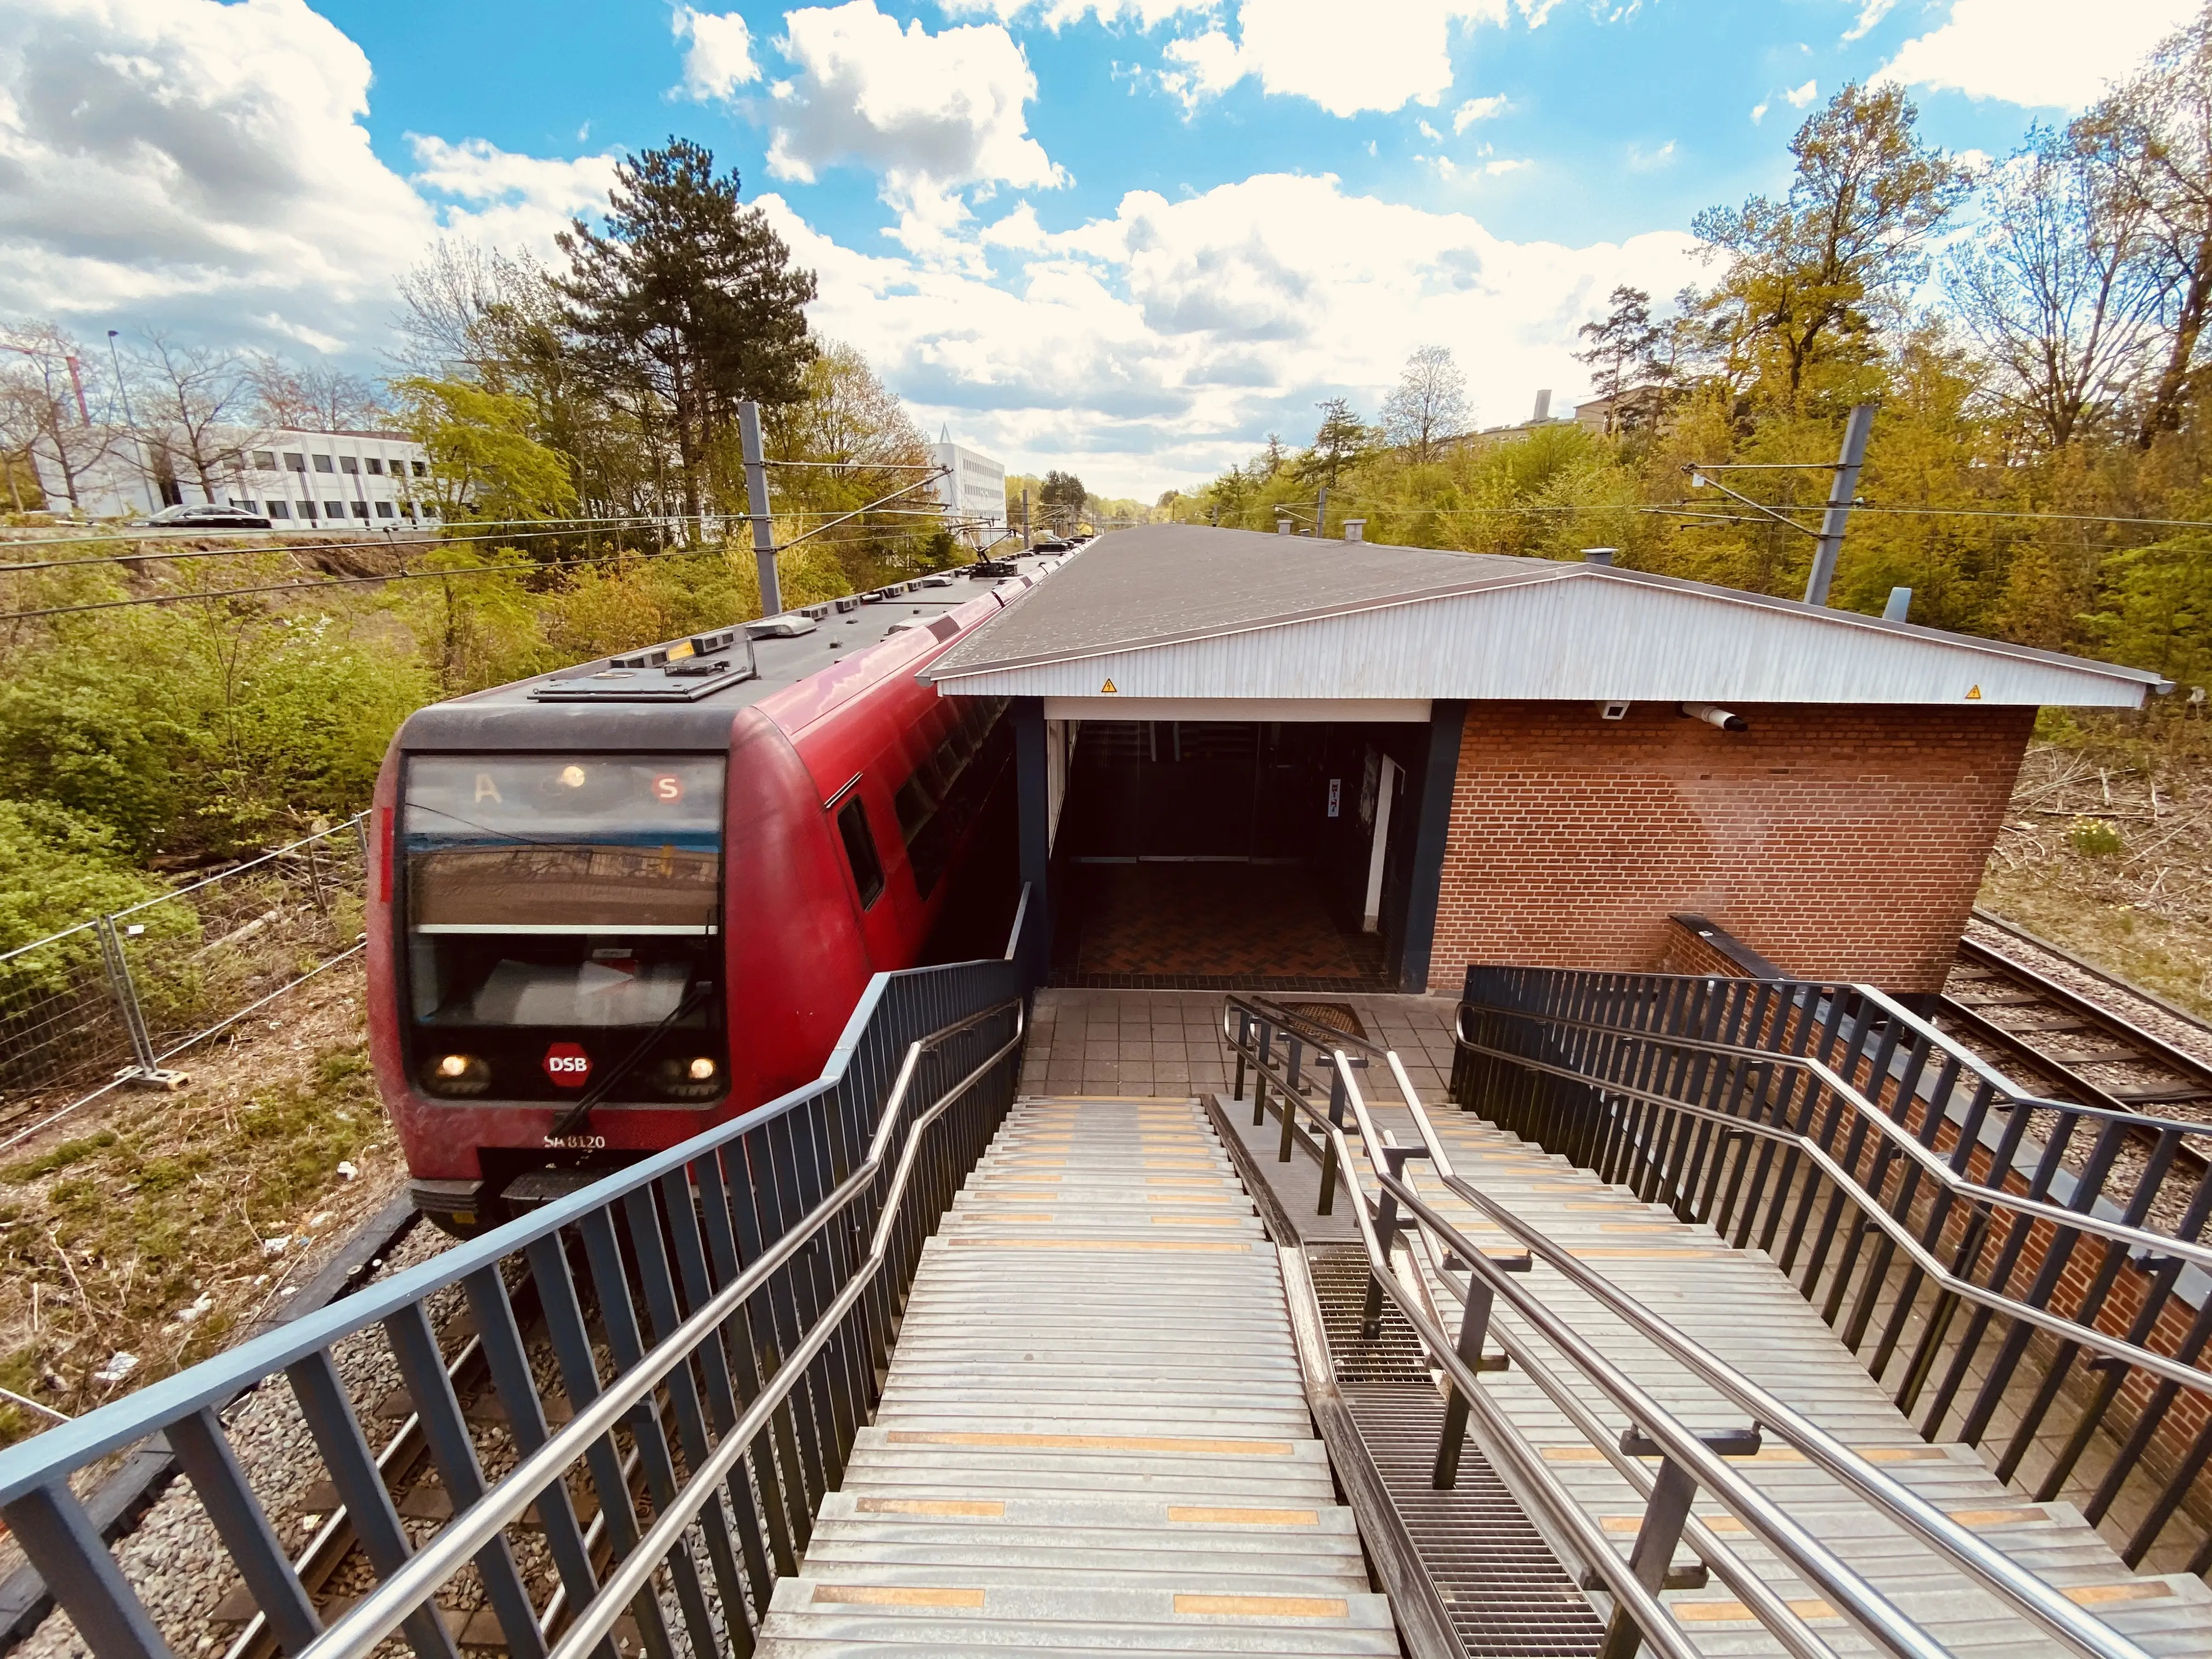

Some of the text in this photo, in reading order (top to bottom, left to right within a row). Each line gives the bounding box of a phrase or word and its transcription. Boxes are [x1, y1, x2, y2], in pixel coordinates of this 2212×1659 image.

[475, 772, 503, 803] A
[658, 778, 678, 798] S
[549, 1057, 588, 1072] DSB
[567, 1135, 606, 1148] 8120
